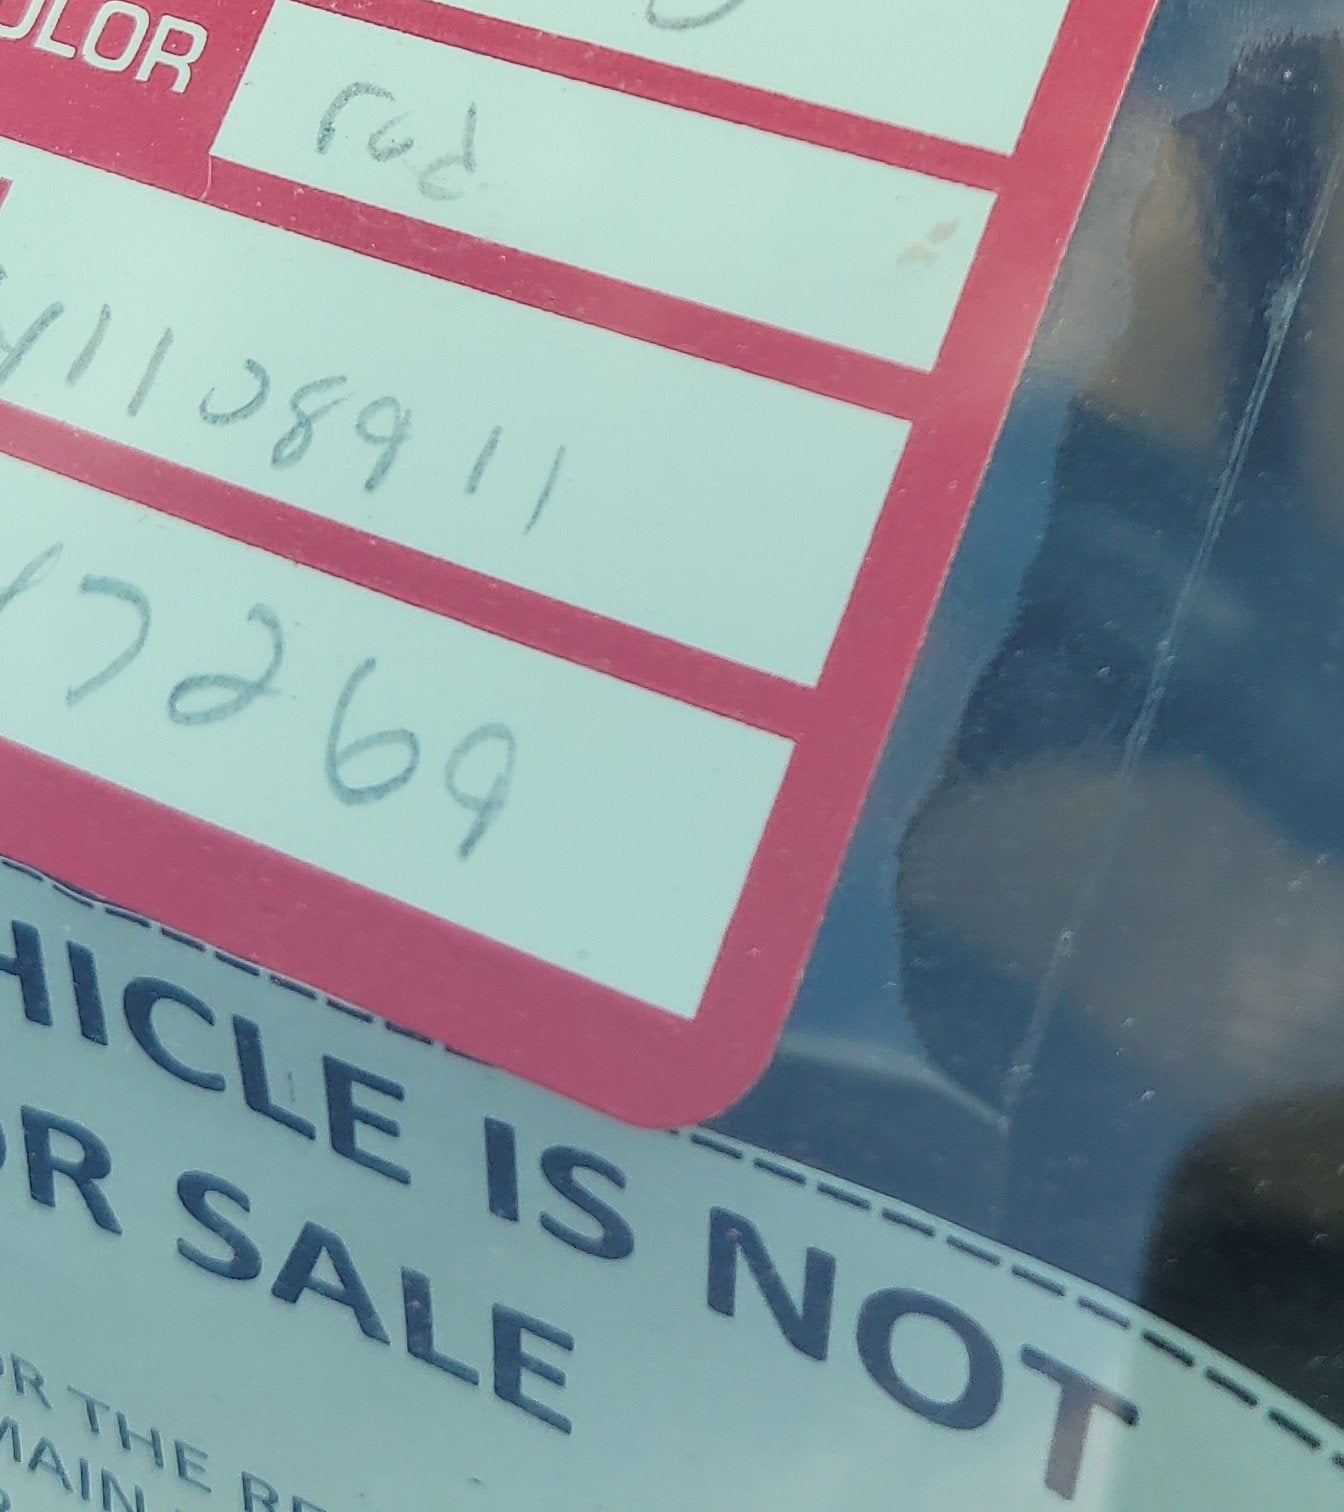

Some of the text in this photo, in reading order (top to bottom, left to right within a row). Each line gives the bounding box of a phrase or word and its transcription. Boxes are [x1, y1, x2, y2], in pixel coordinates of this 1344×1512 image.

[176, 1170, 576, 1435] SALE
[484, 1116, 636, 1260] IS
[706, 1205, 1140, 1502] NOT
[66, 1385, 213, 1493] THE
